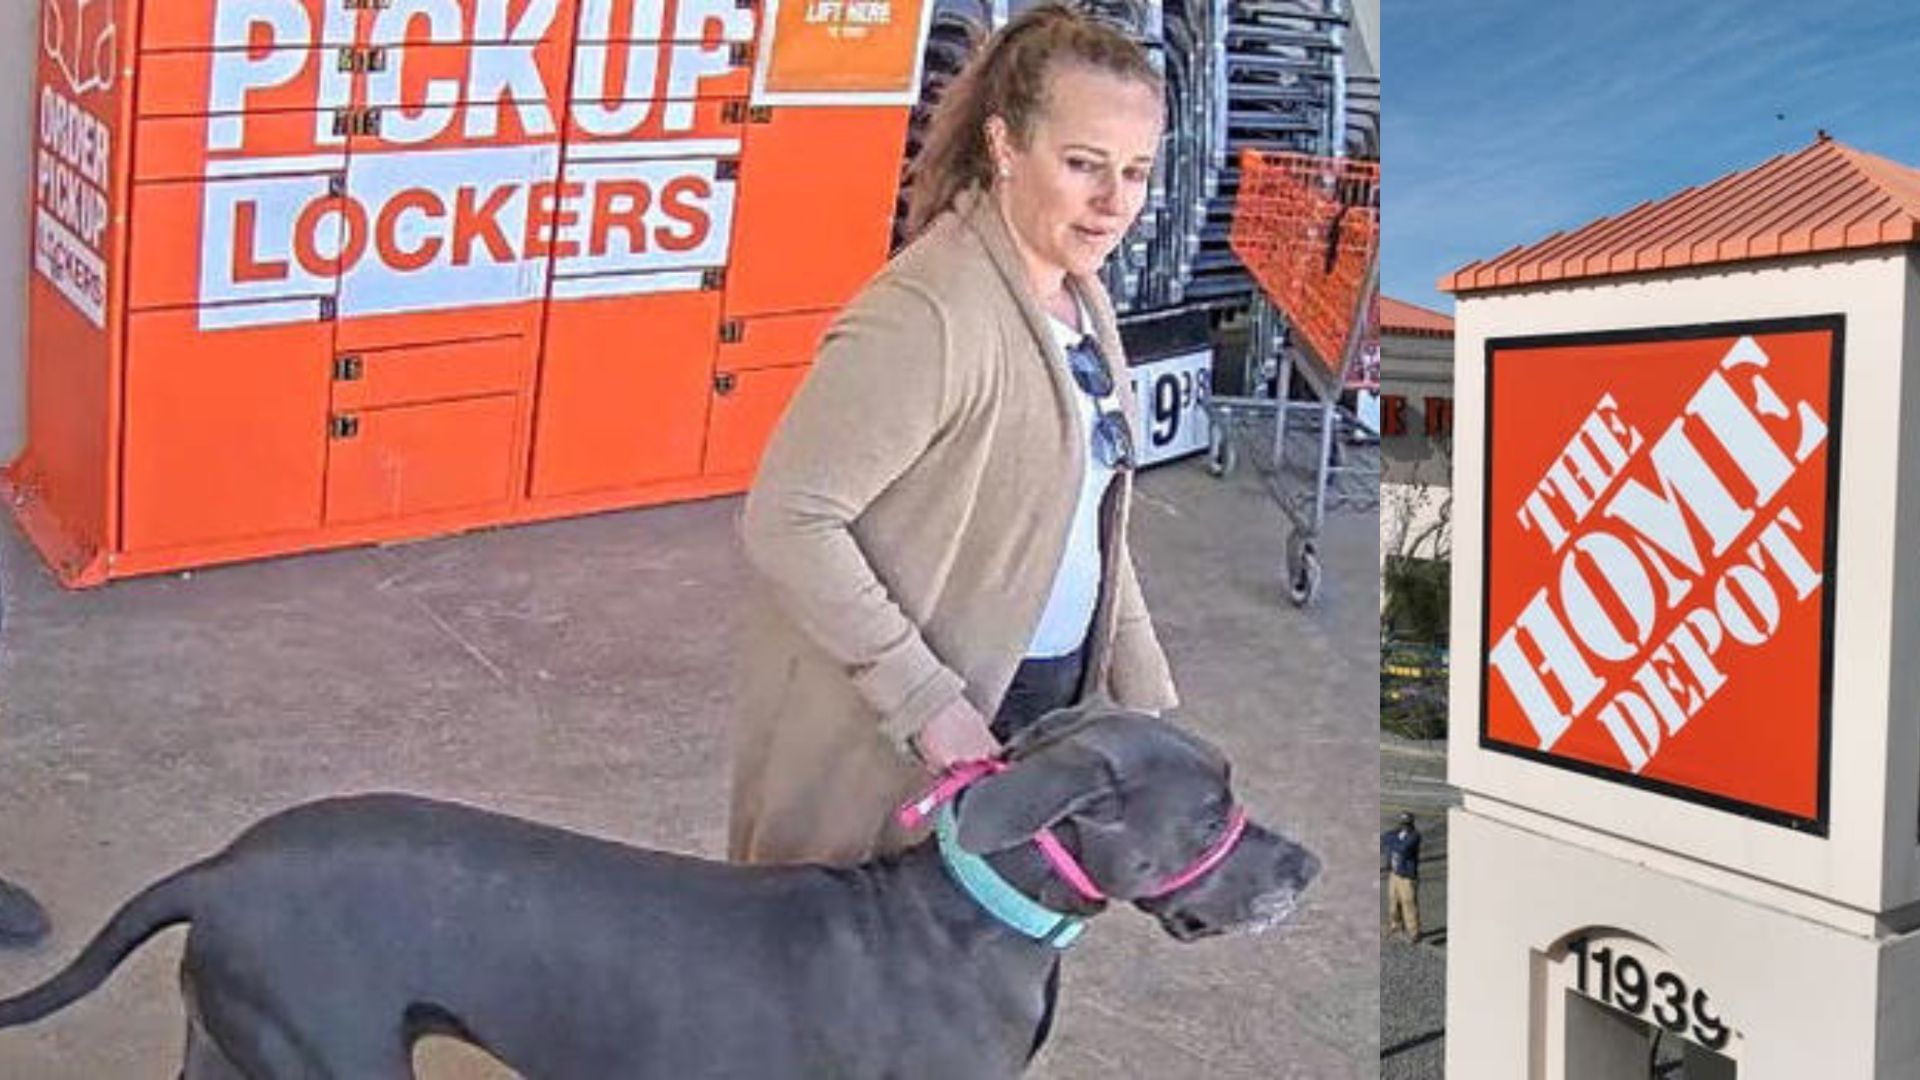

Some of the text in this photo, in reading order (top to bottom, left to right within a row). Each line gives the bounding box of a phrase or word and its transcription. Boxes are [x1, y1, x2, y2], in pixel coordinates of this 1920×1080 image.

[40, 85, 109, 191] ORDER
[206, 0, 756, 150] PICKUP
[37, 148, 107, 250] PICKUP
[232, 176, 710, 282] LOCKERS
[1516, 390, 1646, 554] THE
[1489, 335, 1829, 752] HOME
[1596, 505, 1824, 774] DEPOT
[1568, 936, 1729, 1051] 11939
